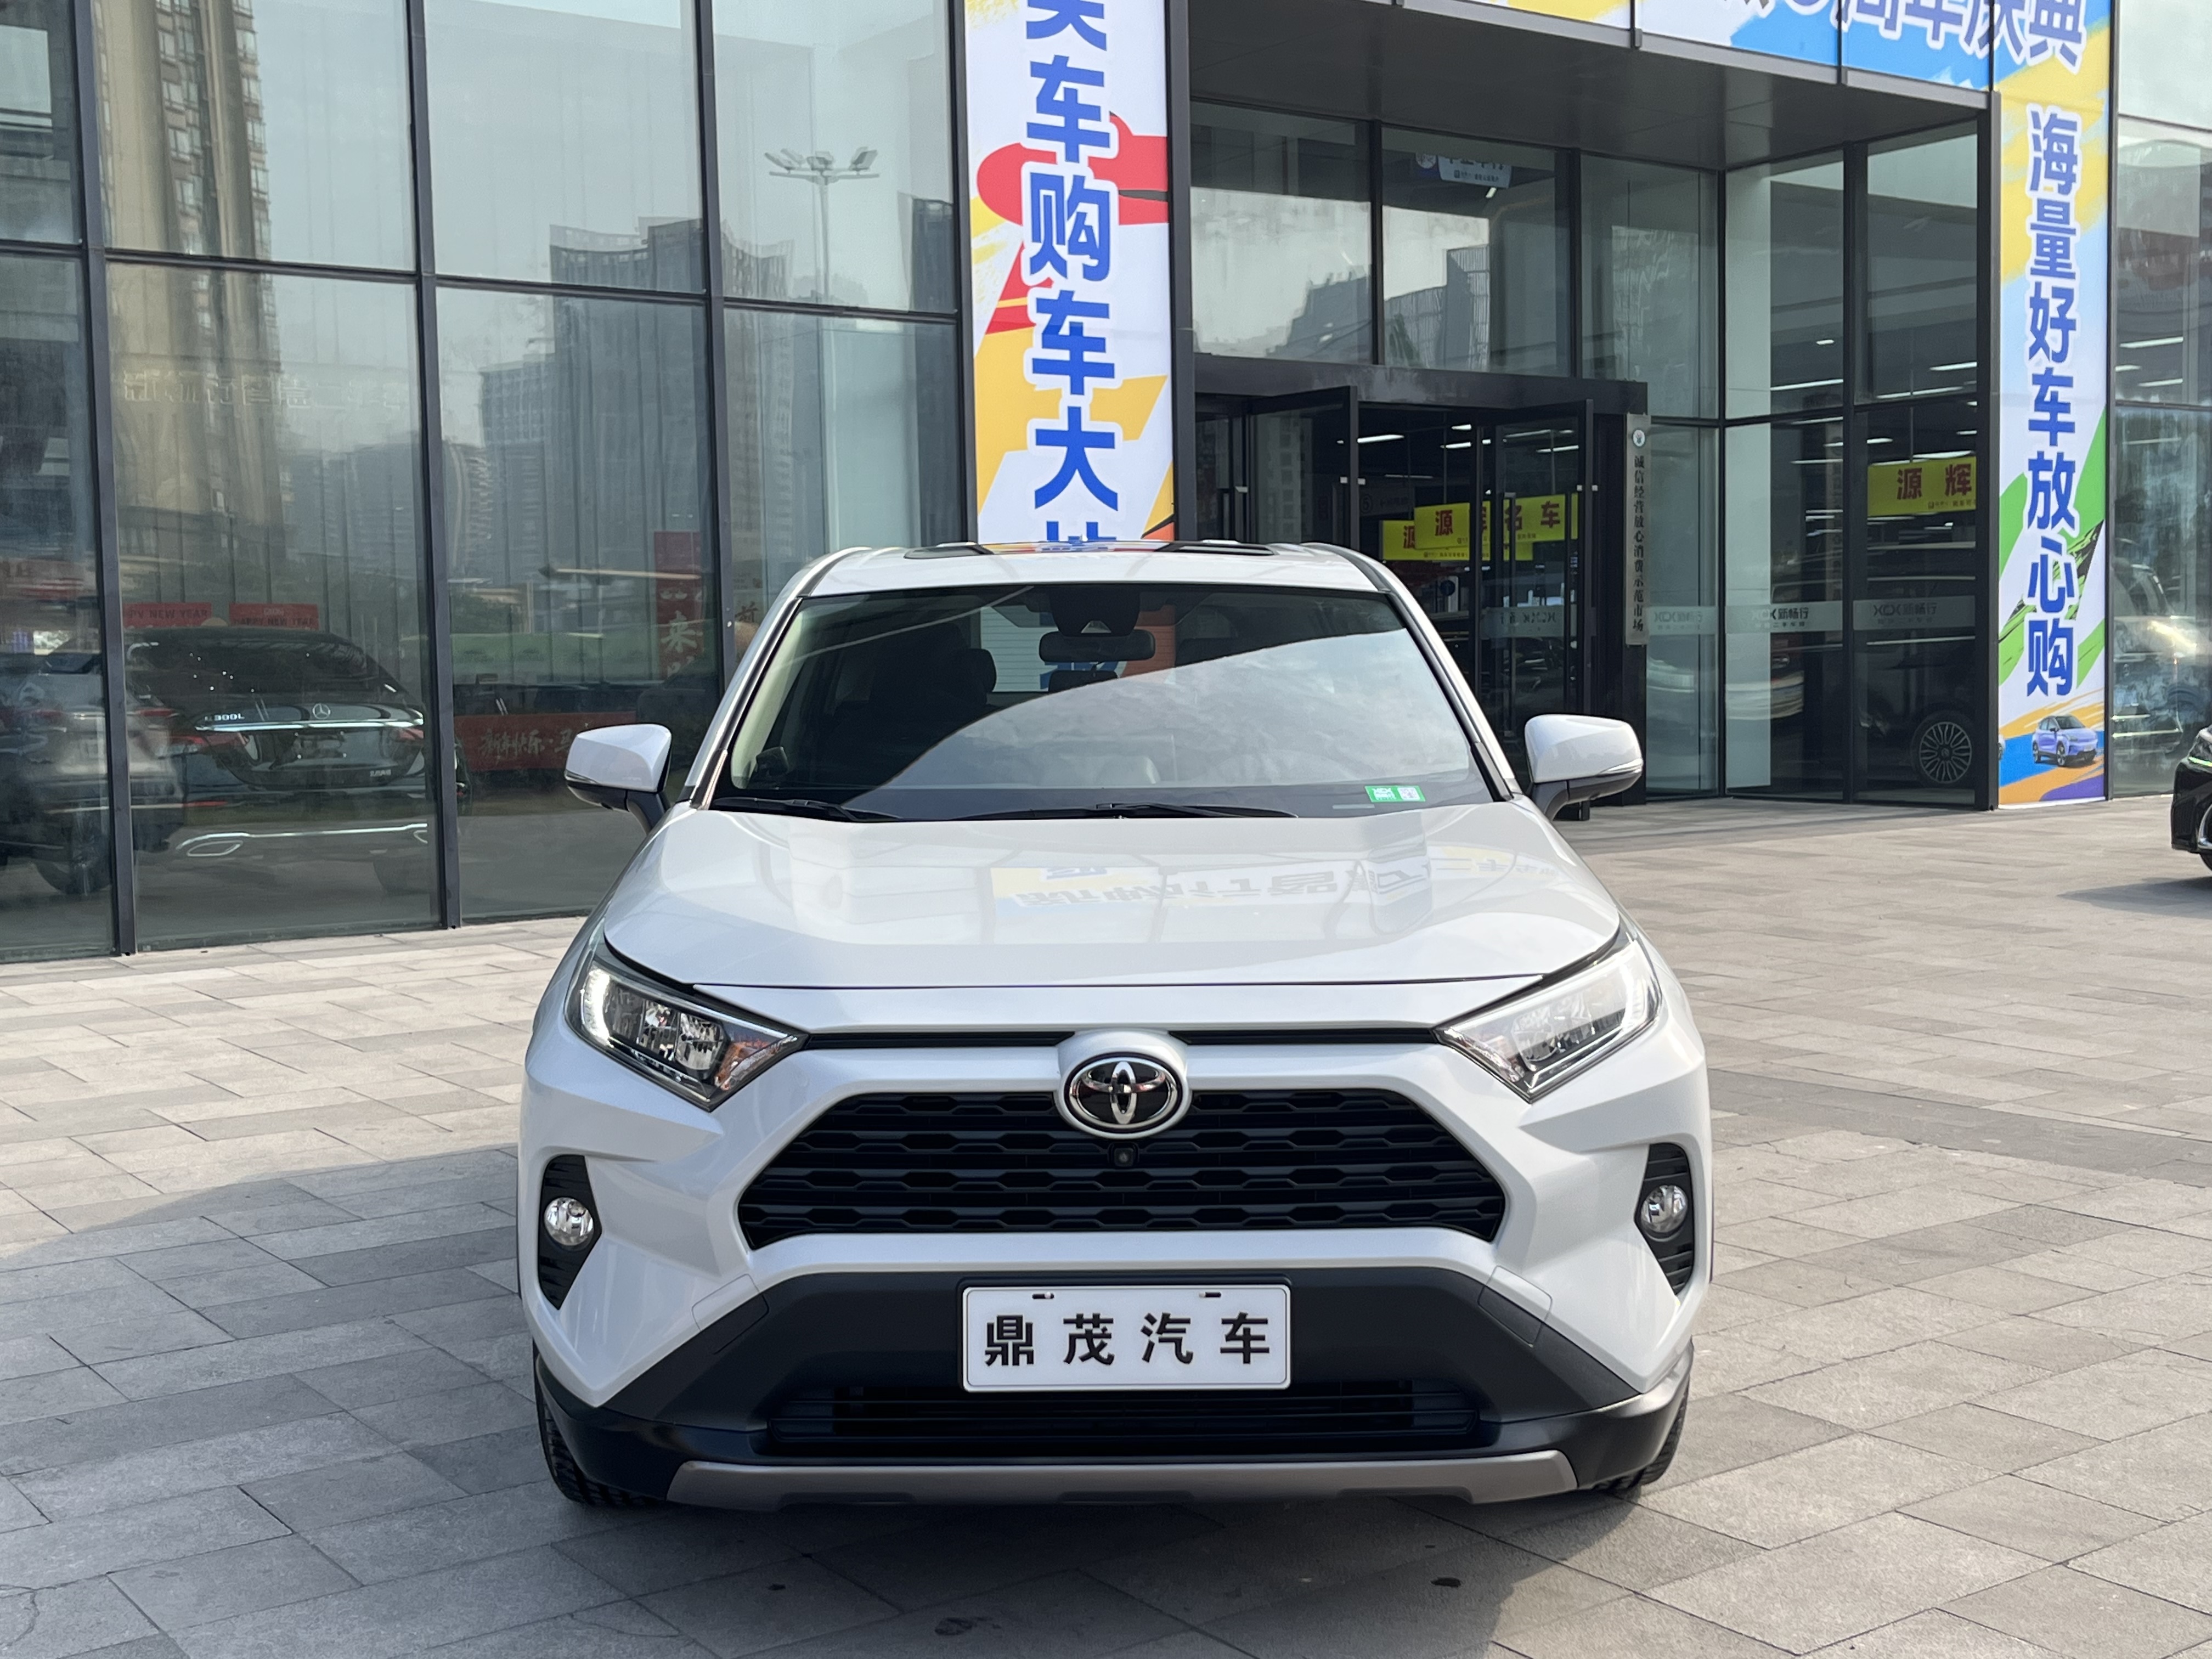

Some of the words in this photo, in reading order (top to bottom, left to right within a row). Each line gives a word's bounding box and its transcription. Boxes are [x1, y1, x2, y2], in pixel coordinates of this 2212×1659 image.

[1026, 0, 1119, 542] 车购车大
[1897, 464, 1972, 500] 源辉
[2027, 110, 2078, 697] 海量好车放心购
[1632, 455, 1645, 633] 诚信经营放心消费示范市场
[985, 1311, 1270, 1367] 鼎茂汽车
